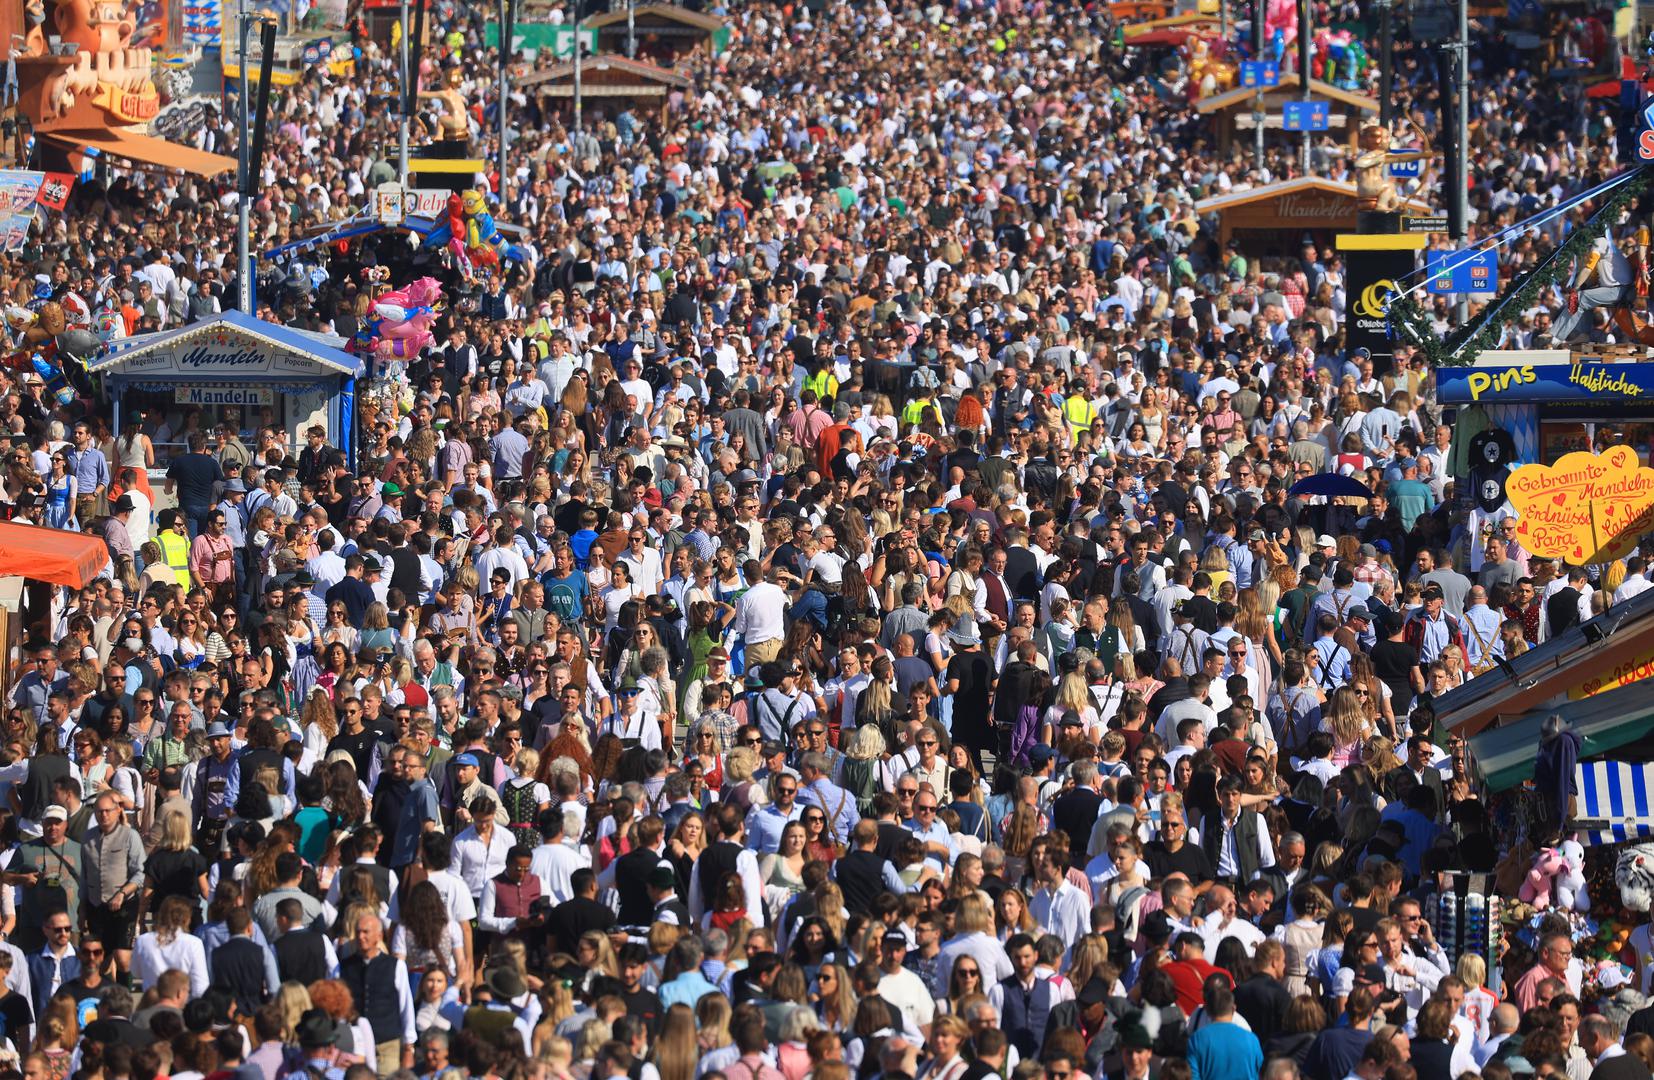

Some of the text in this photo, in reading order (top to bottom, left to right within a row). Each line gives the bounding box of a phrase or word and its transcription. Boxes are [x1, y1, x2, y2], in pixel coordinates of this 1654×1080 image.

[1474, 268, 1485, 276] U3
[1473, 280, 1485, 288] U6
[181, 347, 266, 368] Mandeln
[284, 356, 313, 368] Popcorn
[1467, 364, 1537, 400] Pins
[1569, 363, 1644, 397] Halstücher
[189, 389, 259, 404] Mandeln
[1517, 463, 1602, 492] Gebrannte
[1578, 472, 1654, 500] Mandeln
[1525, 503, 1592, 526] Erdnüsse
[1532, 527, 1578, 549] Para
